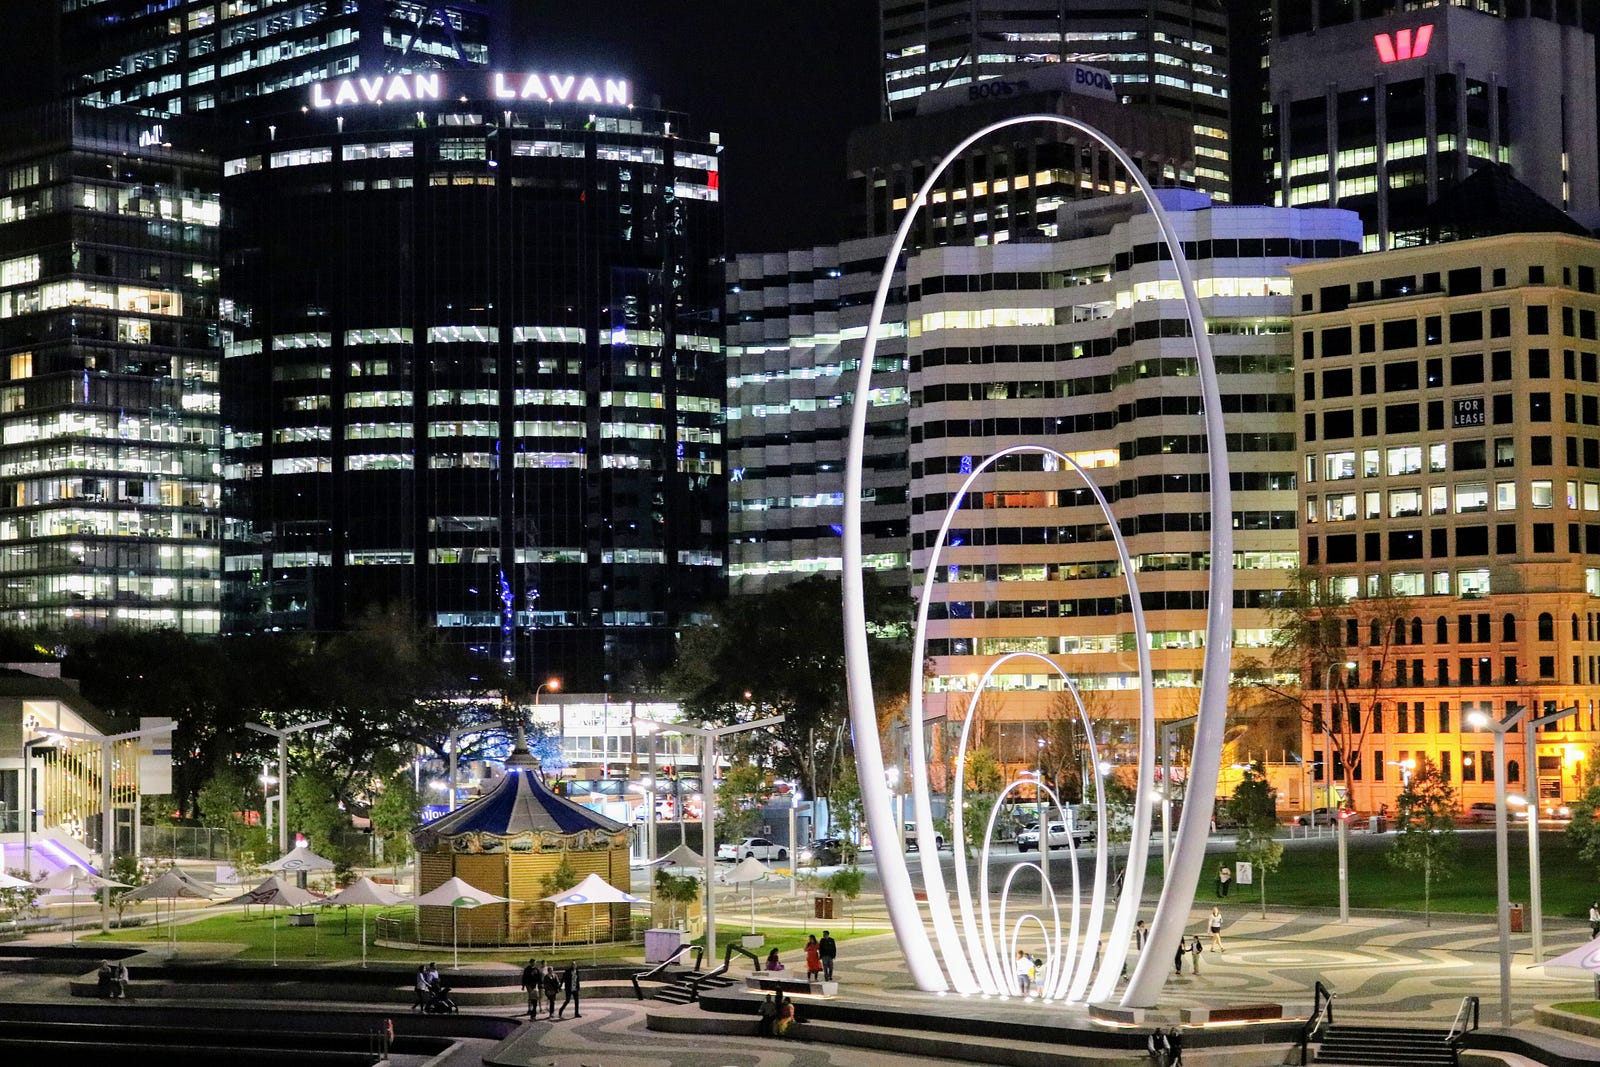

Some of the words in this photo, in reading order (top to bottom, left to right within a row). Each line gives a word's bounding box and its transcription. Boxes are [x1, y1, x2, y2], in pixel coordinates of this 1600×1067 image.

[313, 73, 440, 108] LAVAN
[494, 72, 629, 105] LAVAN
[1459, 400, 1479, 412] FOR
[1454, 412, 1485, 425] LEASE
